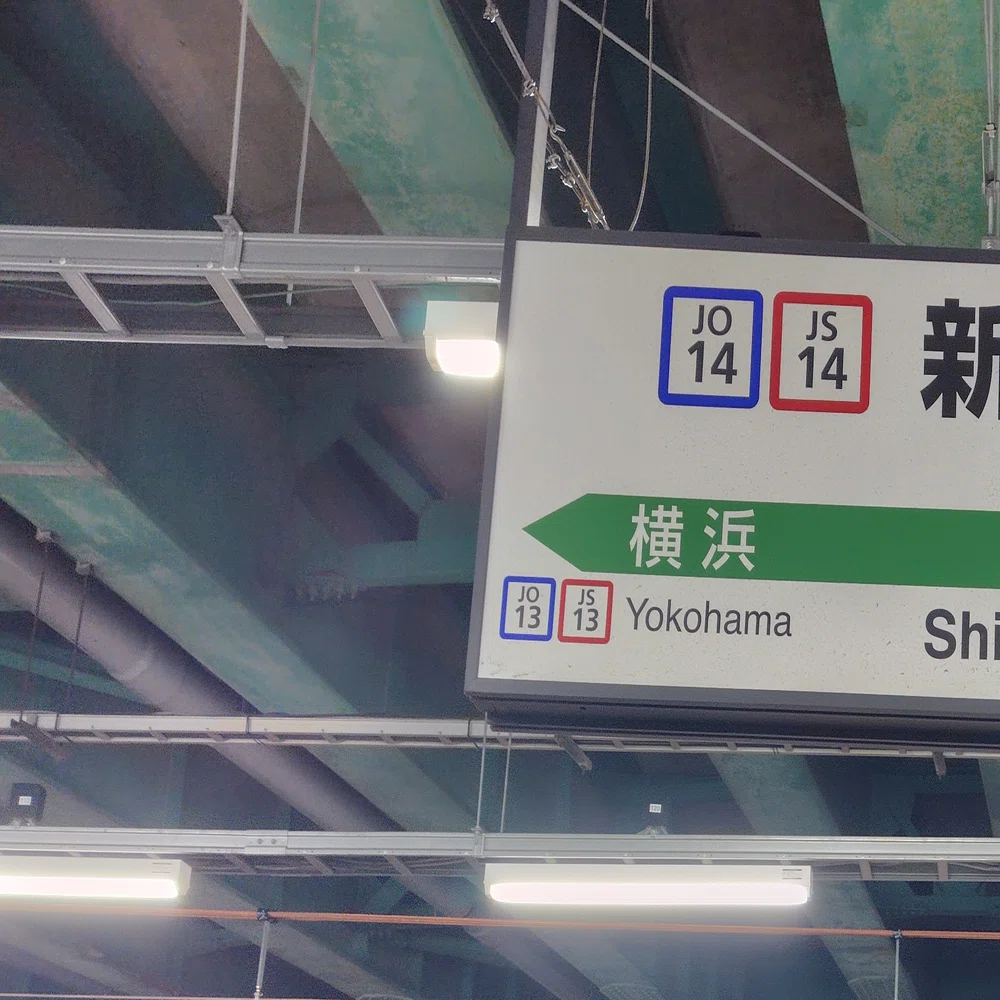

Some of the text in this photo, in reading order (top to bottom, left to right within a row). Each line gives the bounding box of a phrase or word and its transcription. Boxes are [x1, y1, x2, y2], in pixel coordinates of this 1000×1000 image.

[691, 304, 734, 337] JO
[805, 310, 839, 342] JS
[687, 340, 738, 385] 14
[797, 345, 848, 390] 14
[628, 503, 757, 573] 横浜
[517, 585, 540, 603] JO
[577, 588, 596, 606] JS
[515, 605, 542, 629] 13
[573, 607, 599, 632] 13
[626, 597, 793, 637] Yokohama
